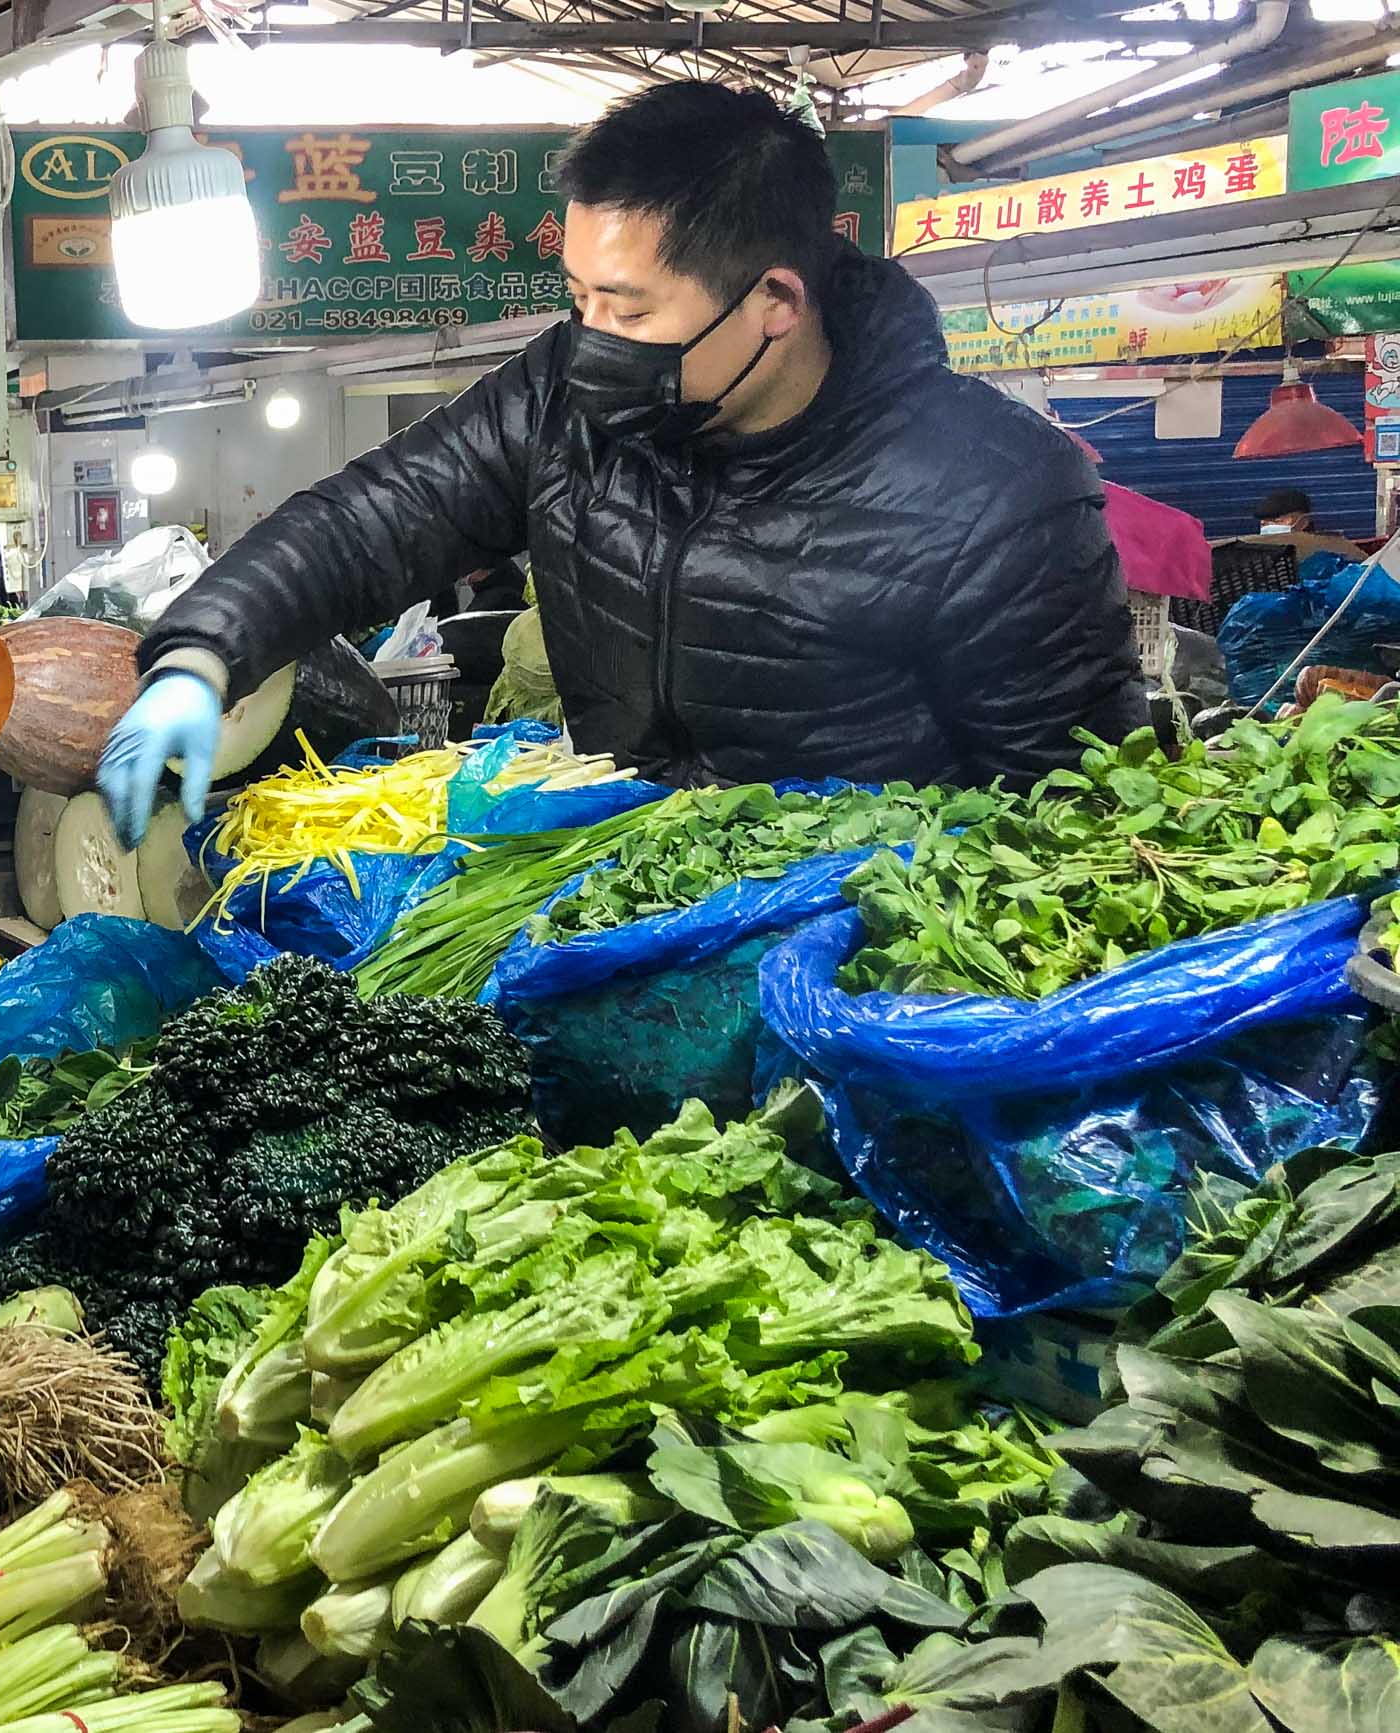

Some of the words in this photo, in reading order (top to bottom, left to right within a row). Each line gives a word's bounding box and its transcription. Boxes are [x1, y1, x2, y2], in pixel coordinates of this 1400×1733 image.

[39, 148, 112, 182] AL
[1320, 100, 1390, 168] 陆
[914, 151, 1260, 245] 大别山散养土鸡蛋
[260, 210, 566, 266] 安蓝豆类食
